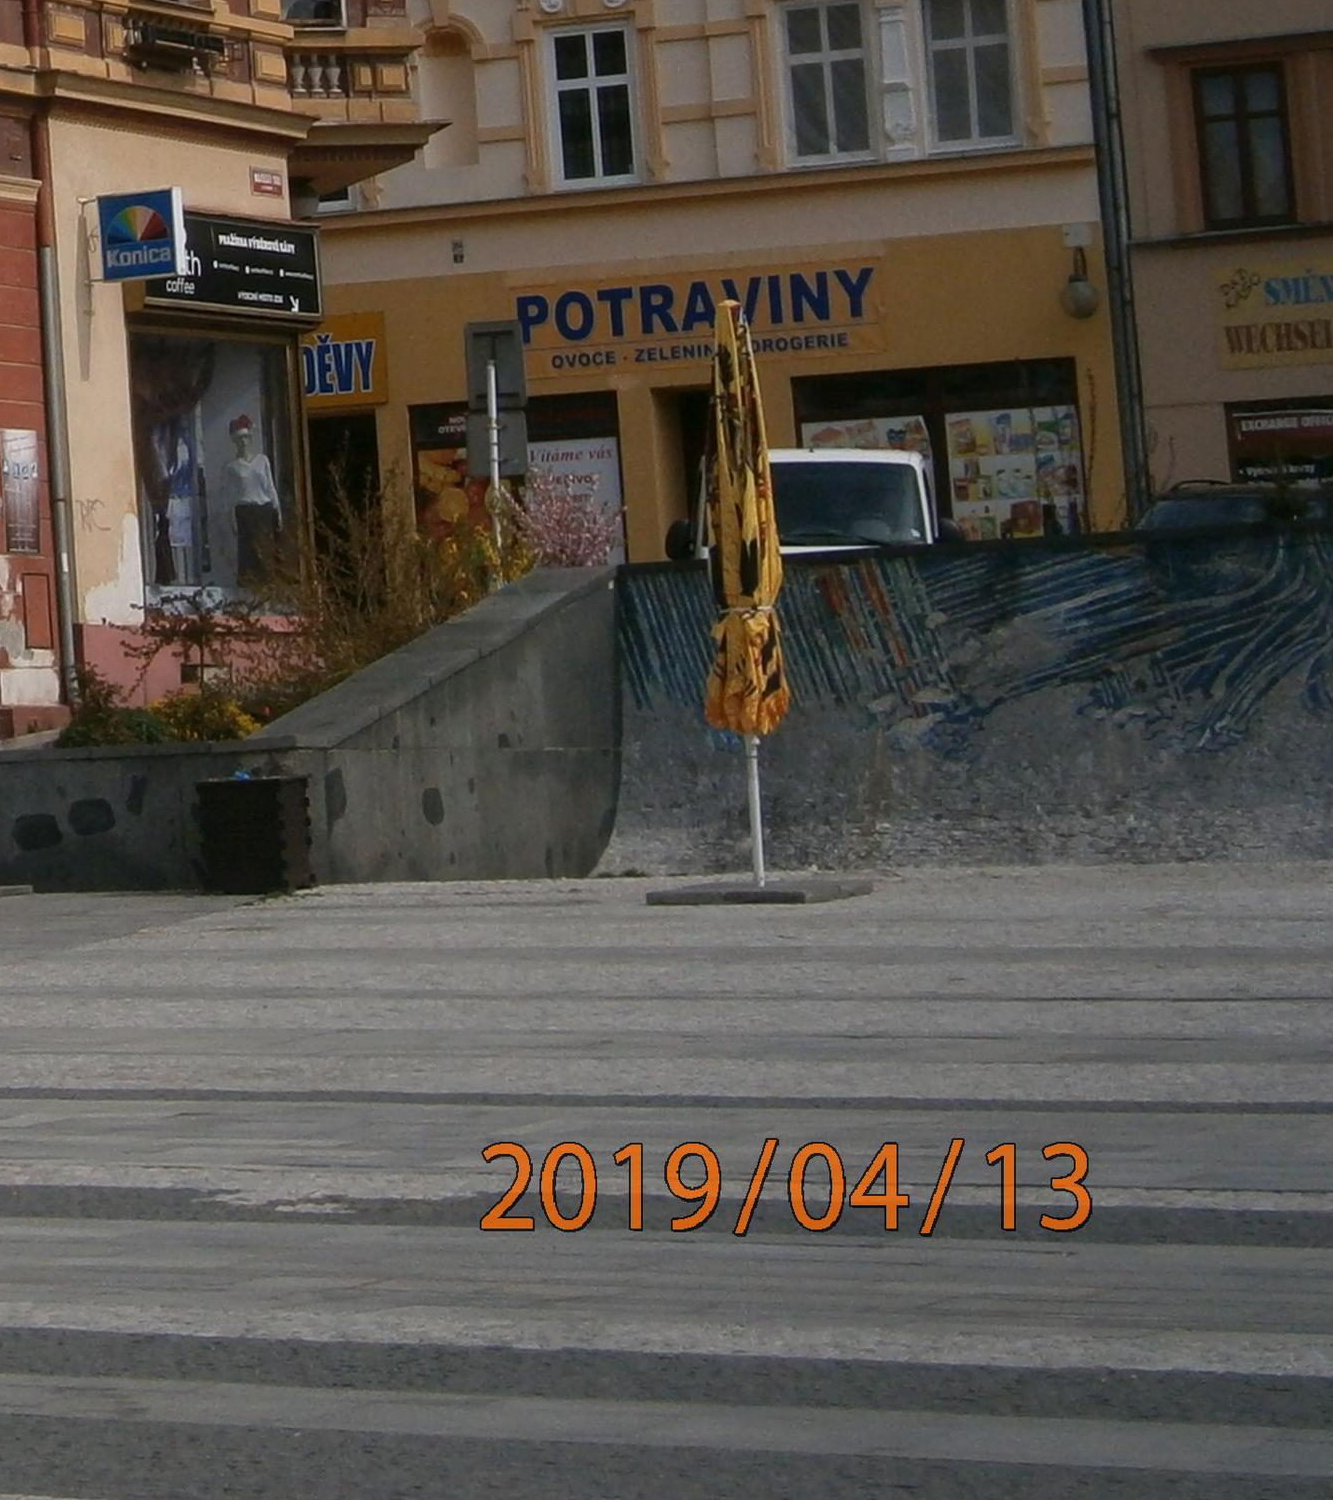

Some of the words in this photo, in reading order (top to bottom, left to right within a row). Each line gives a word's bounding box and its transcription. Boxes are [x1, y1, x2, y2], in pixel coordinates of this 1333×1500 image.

[107, 245, 172, 268] Konica
[166, 276, 196, 295] coffee
[516, 267, 875, 345] POTRAVINY
[551, 350, 617, 369] OVOCE
[634, 343, 716, 363] ZELENIN
[751, 332, 849, 353] DROGERIE
